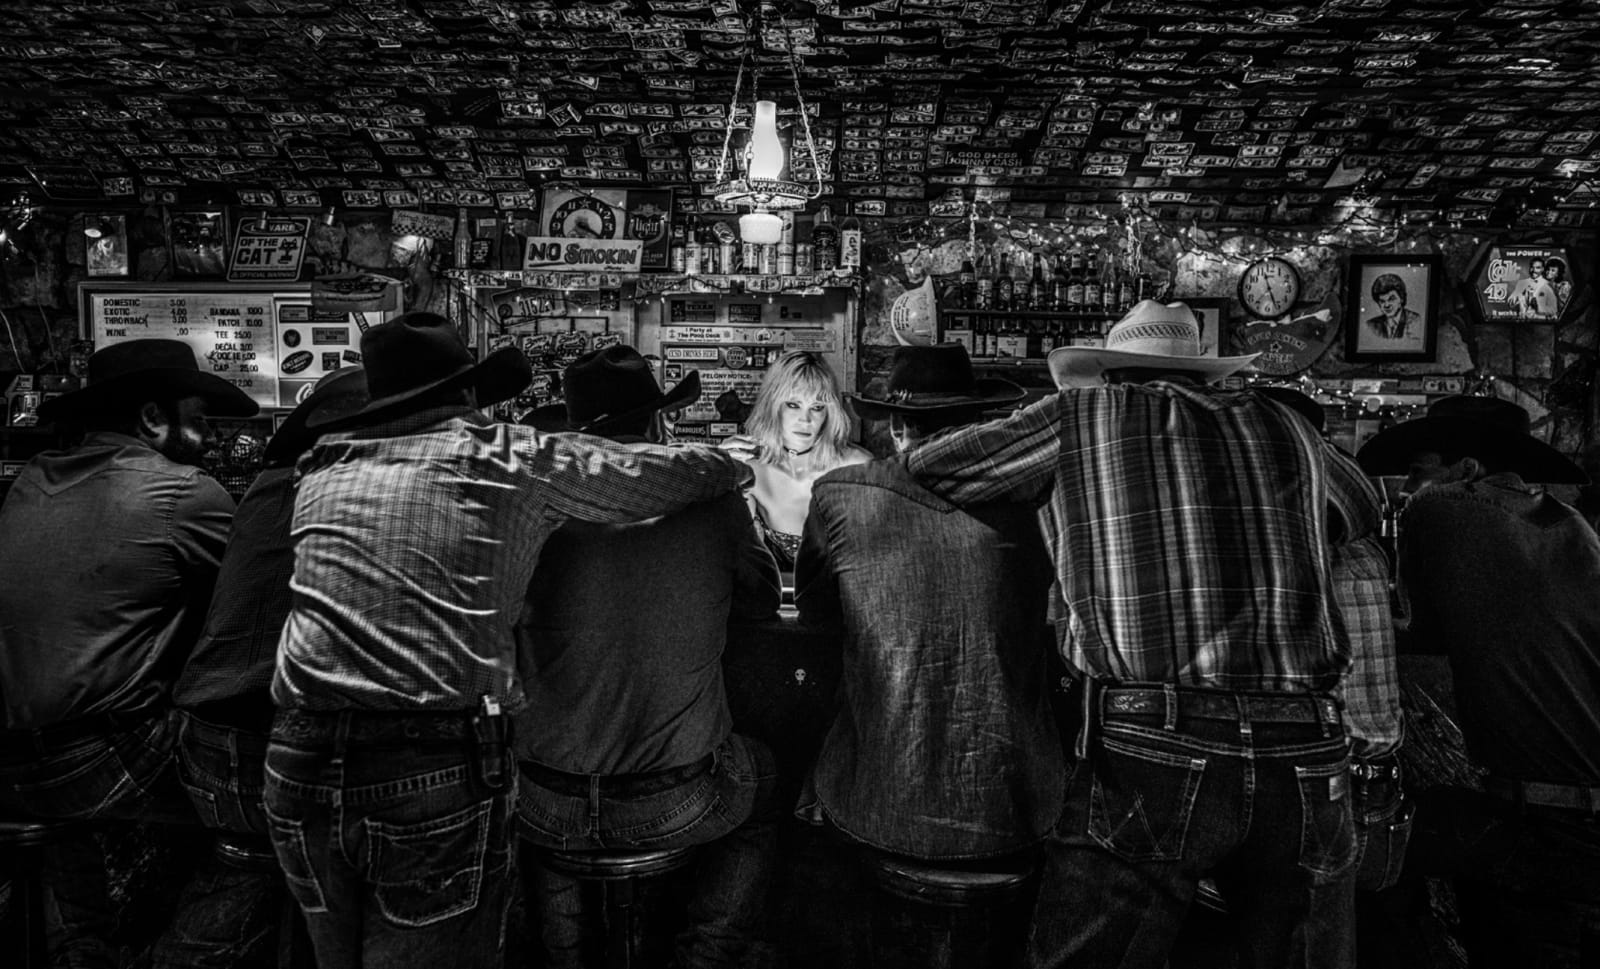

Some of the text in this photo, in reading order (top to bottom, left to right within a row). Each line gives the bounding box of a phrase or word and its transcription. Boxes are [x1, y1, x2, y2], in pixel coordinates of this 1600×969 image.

[949, 158, 1022, 166] JOHNNY CASH
[529, 243, 562, 261] NO
[236, 250, 276, 264] CAT
[104, 299, 141, 307] DOMESTIC
[1265, 303, 1270, 312] 6
